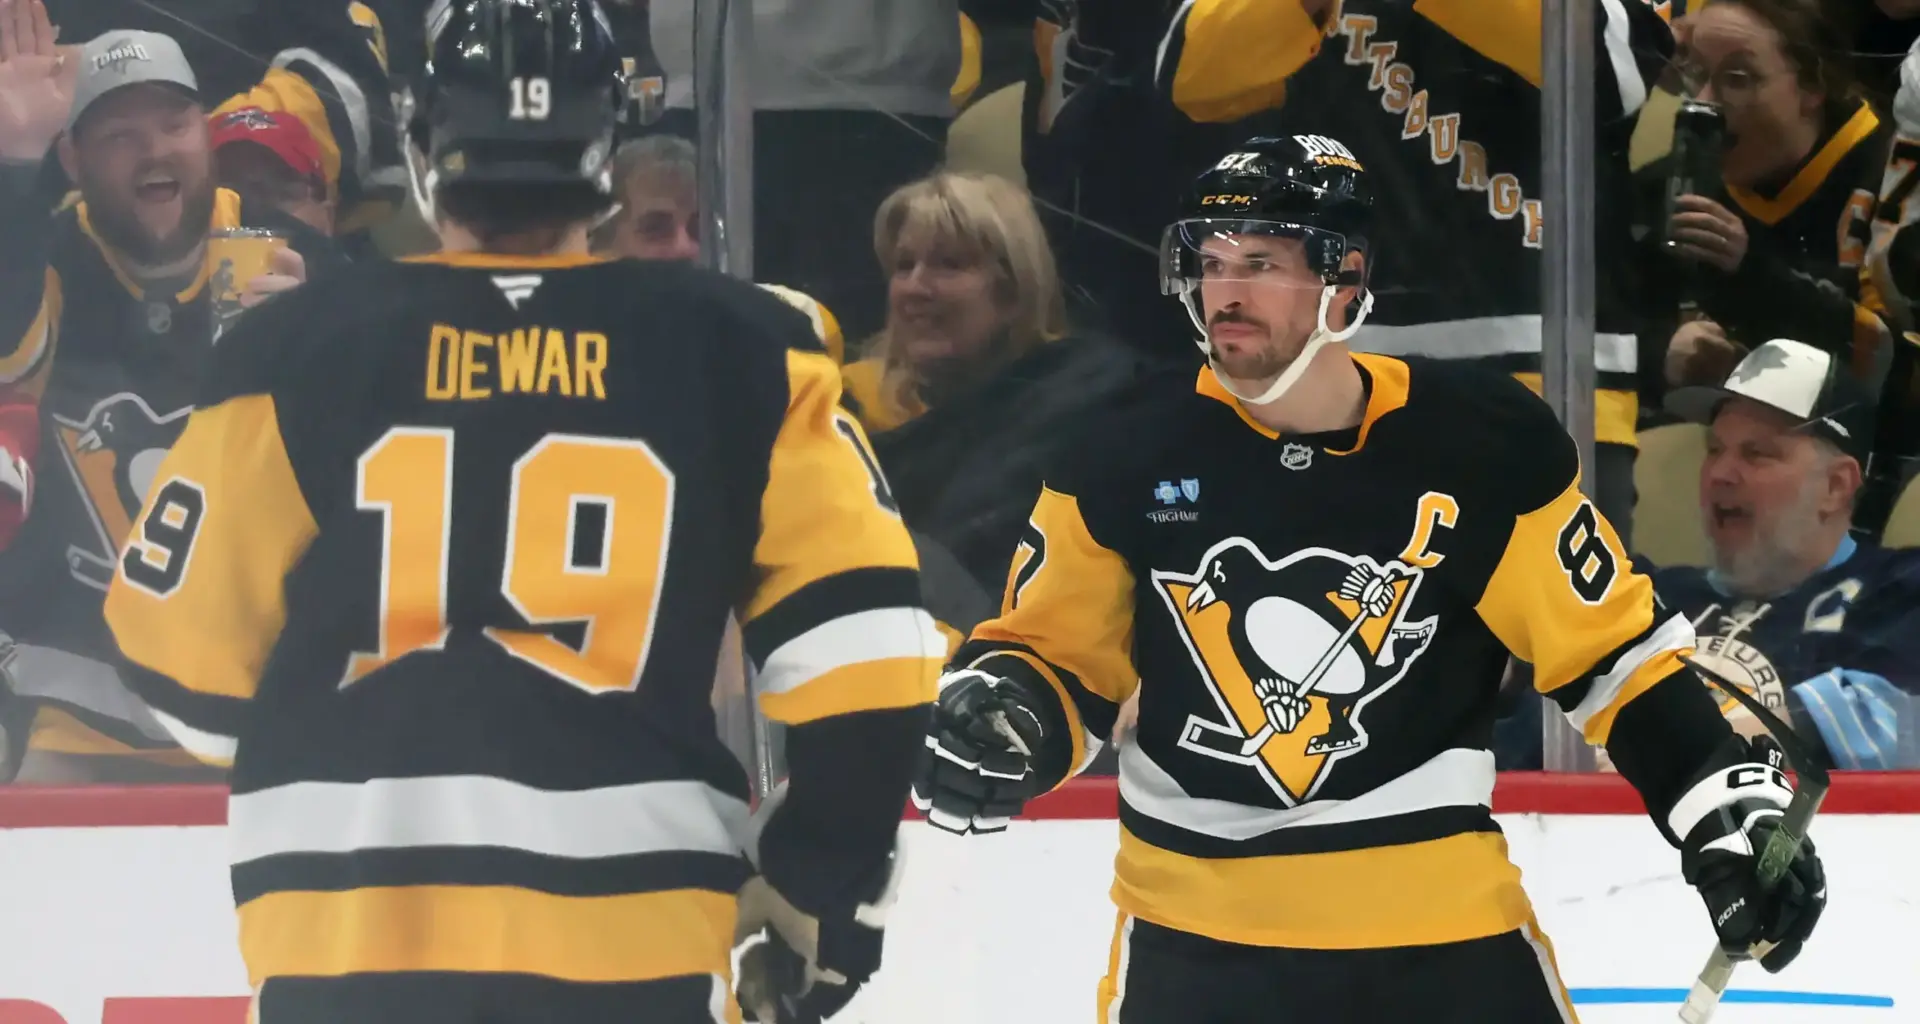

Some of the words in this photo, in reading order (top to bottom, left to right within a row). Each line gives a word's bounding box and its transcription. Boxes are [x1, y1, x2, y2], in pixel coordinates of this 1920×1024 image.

[508, 77, 551, 120] 19
[1215, 152, 1261, 171] 87
[1292, 133, 1357, 162] BOLD
[1201, 194, 1250, 206] CCM
[425, 323, 609, 400] DEWAR
[119, 474, 208, 600] 9
[1398, 490, 1460, 569] C
[340, 426, 677, 696] 19
[1555, 499, 1618, 606] 8
[1769, 749, 1783, 767] 87
[1717, 897, 1746, 928] CCM
